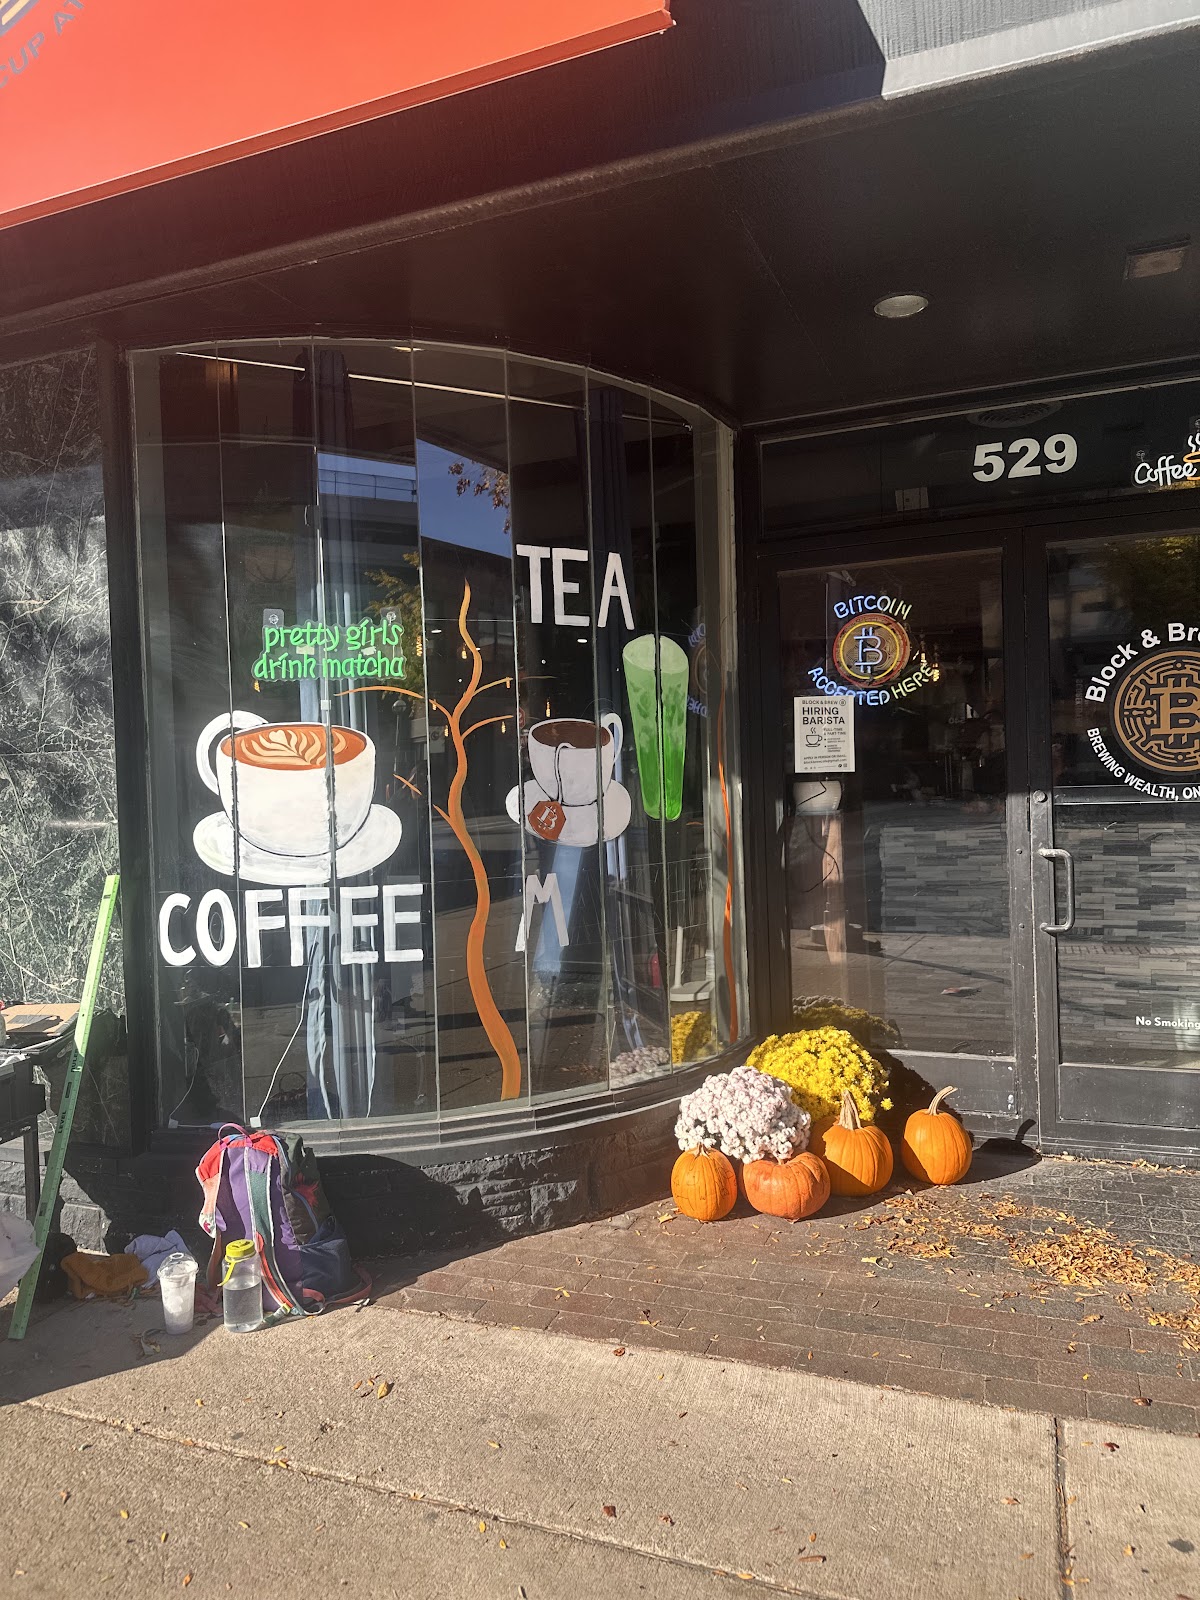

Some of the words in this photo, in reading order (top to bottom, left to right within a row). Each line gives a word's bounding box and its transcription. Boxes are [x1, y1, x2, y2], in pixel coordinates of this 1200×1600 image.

[972, 433, 1078, 482] 529
[1134, 455, 1198, 486] Coffee
[516, 544, 635, 630] TEA
[833, 595, 912, 620] BITCOIN
[264, 621, 340, 653] pretty
[346, 618, 403, 650] girls
[254, 652, 316, 679] drink
[322, 650, 404, 679] matcha
[1085, 642, 1138, 703] Block
[1141, 629, 1161, 649] &
[1168, 622, 1200, 642] Br
[890, 663, 934, 699] HERE
[803, 707, 839, 716] HIRING
[803, 717, 845, 725] BARISTA
[1087, 727, 1126, 778] BREWING
[1124, 772, 1179, 802] WEALTH,
[158, 883, 424, 968] COFFEE
[1135, 1015, 1152, 1026] No
[1154, 1016, 1200, 1030] Smoking
[58, 1110, 67, 1134] LEVEL
